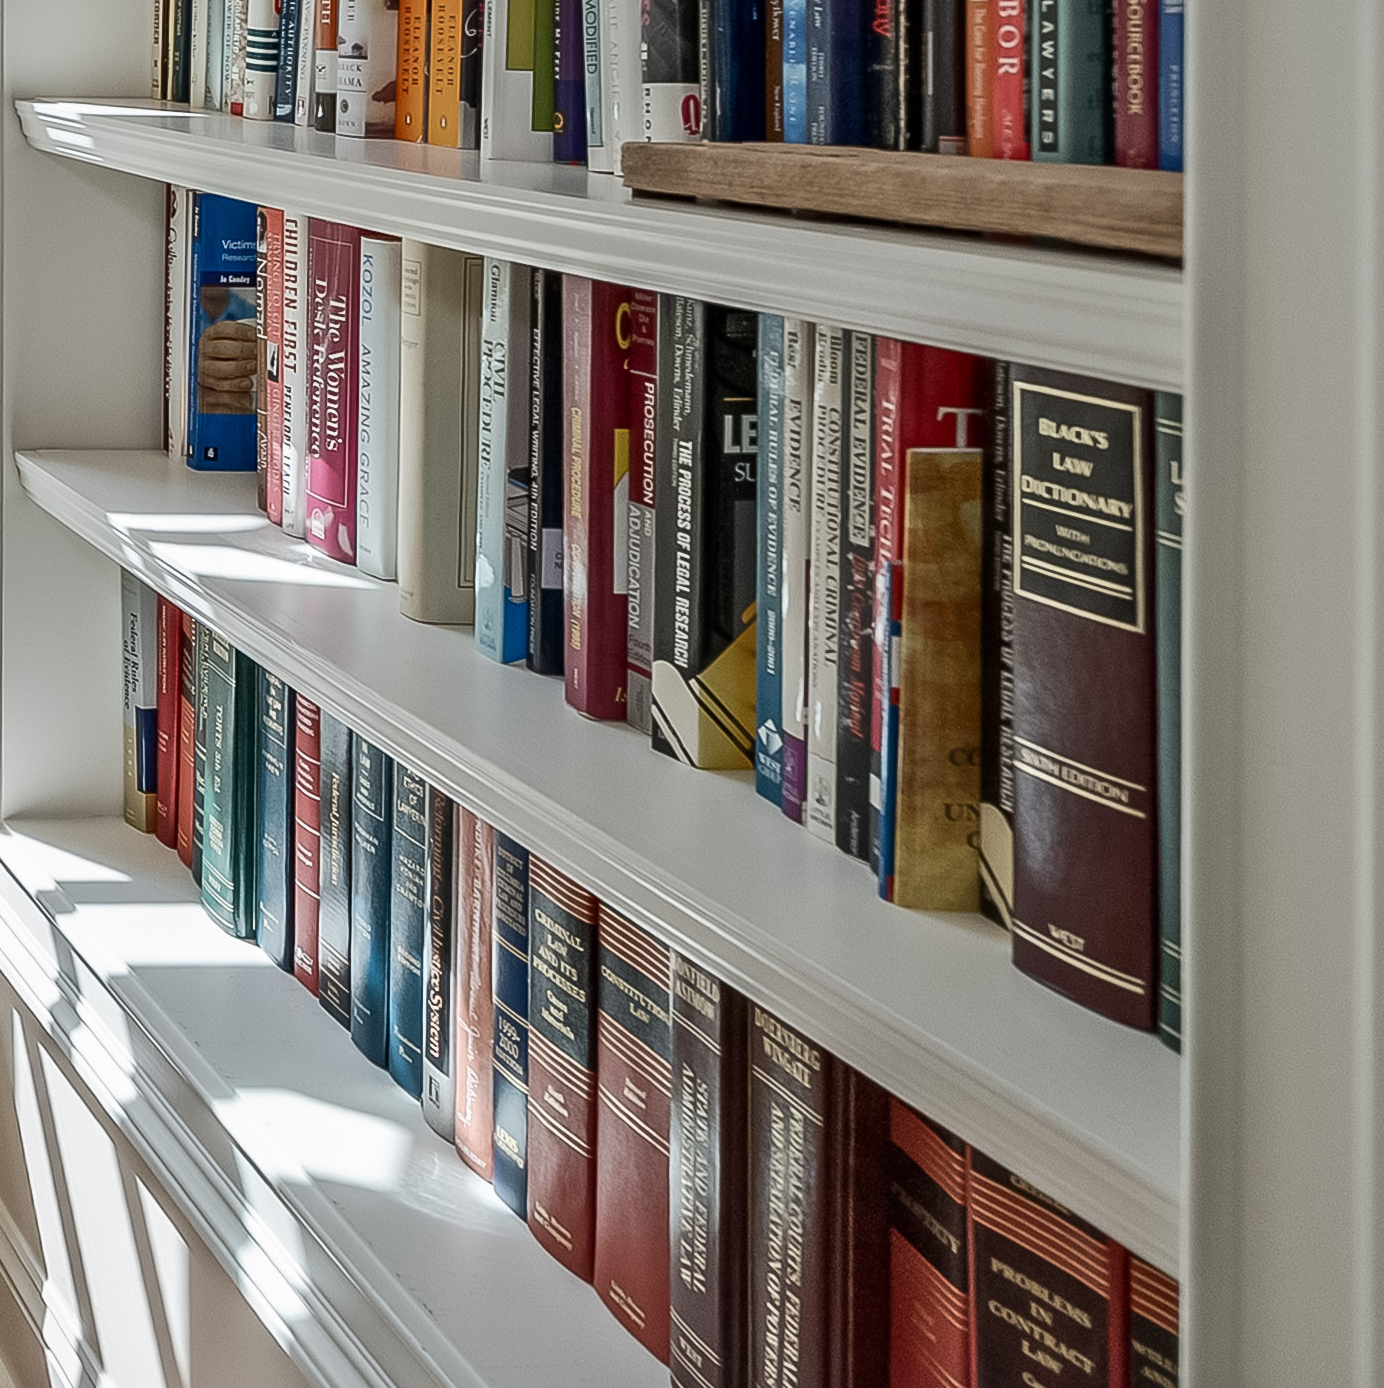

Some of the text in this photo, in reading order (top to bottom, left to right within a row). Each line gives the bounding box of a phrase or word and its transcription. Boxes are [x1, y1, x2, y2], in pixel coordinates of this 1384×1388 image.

[400, 6, 412, 95] ROOSEVELT
[1040, 0, 1056, 144] LAWYERS
[284, 218, 298, 374] CHILDREN FIRST
[307, 277, 330, 459] Desk Reference
[325, 294, 348, 453] The Women's
[357, 252, 374, 529] KOZOL AMAZING GRACE
[642, 381, 655, 506] PROSECUTION
[852, 333, 868, 546] FEDERAL EVIDENCE
[1038, 416, 1108, 451] BLACK'S
[1020, 474, 1134, 520] DICTIONARY
[1052, 451, 1093, 480] LAW
[627, 502, 642, 630] ADJUDICATION
[672, 439, 693, 669] THE PROCESS OF LEGAL RESEARCH
[129, 612, 140, 693] Federal Rules
[534, 908, 584, 952] CRIMINAL
[679, 1062, 696, 1290] ADMINISTRATIVE LAW
[692, 1078, 710, 1294] STATE AND FEDERAL
[764, 1102, 786, 1388] AND SEPARATION OF POWERS
[785, 1106, 805, 1288] FEDERAL COURTS,
[987, 1298, 1096, 1375] CONTRACT
[990, 1257, 1092, 1328] PROBLEMS
